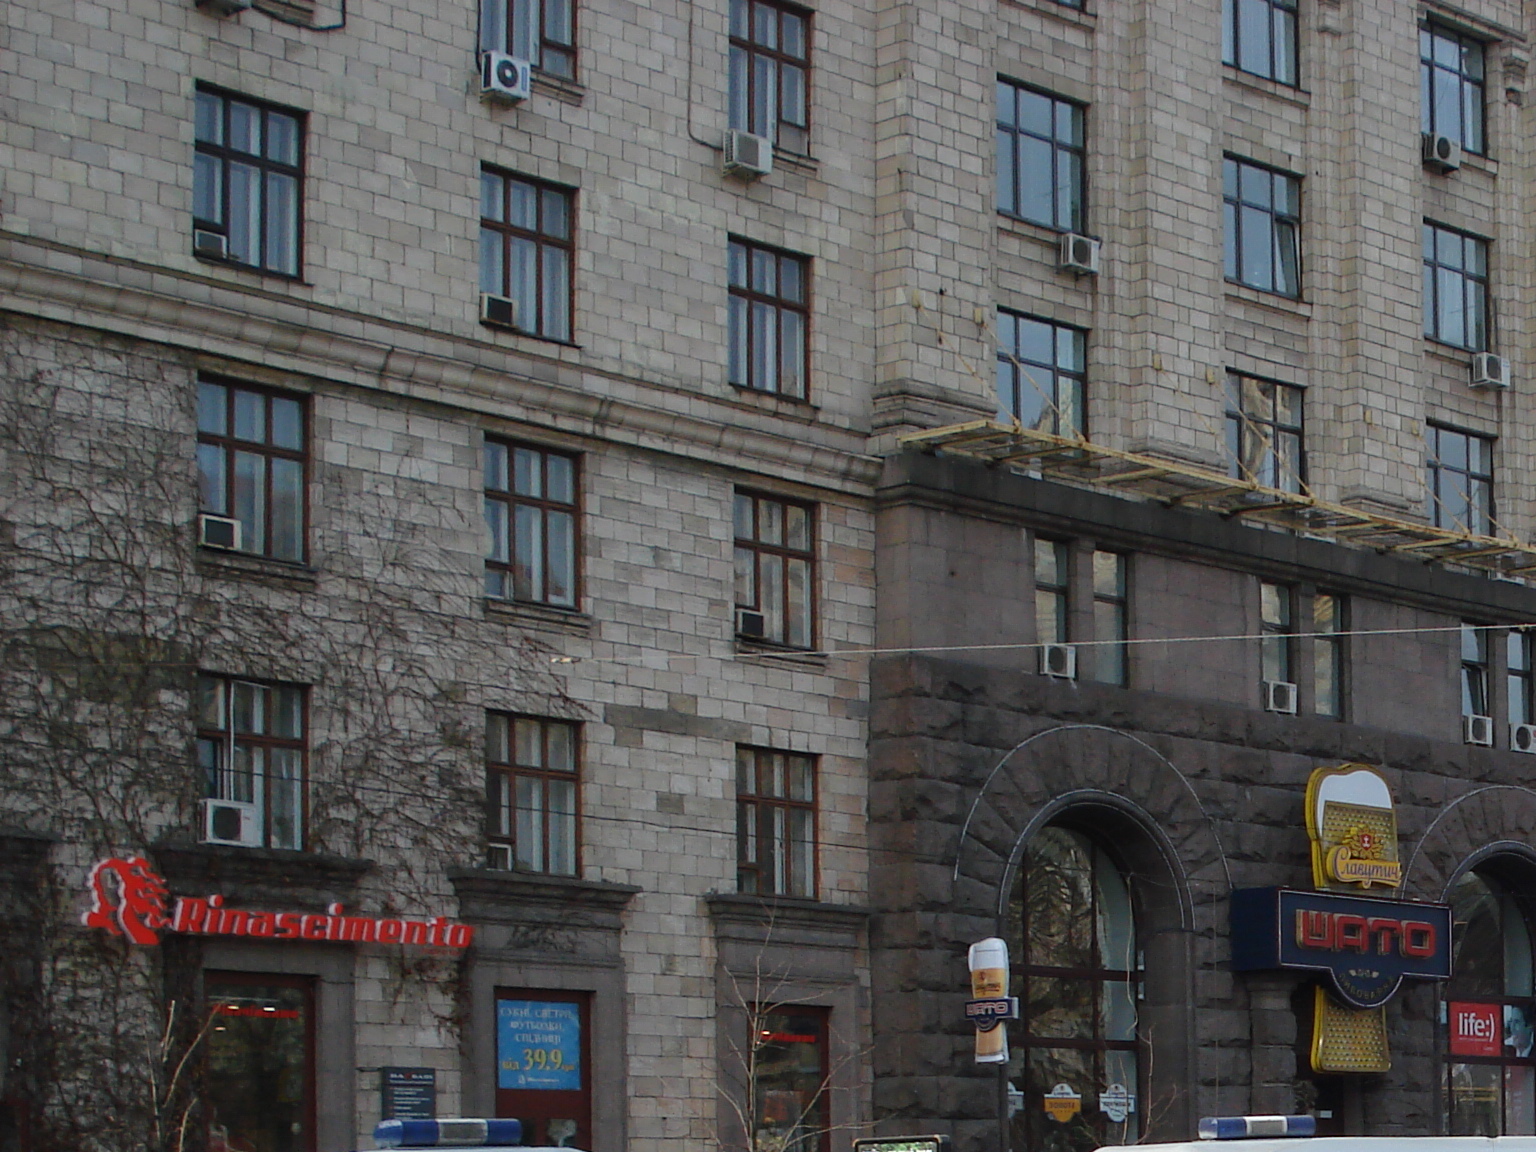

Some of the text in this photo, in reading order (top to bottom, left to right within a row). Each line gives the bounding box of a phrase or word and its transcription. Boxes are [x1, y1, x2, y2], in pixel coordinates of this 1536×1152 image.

[1334, 846, 1400, 883] Славутич
[173, 894, 474, 948] Rinascimento
[1295, 909, 1436, 958] ШАТО
[1459, 1013, 1495, 1042] life:)
[524, 1049, 562, 1070] 39.9
